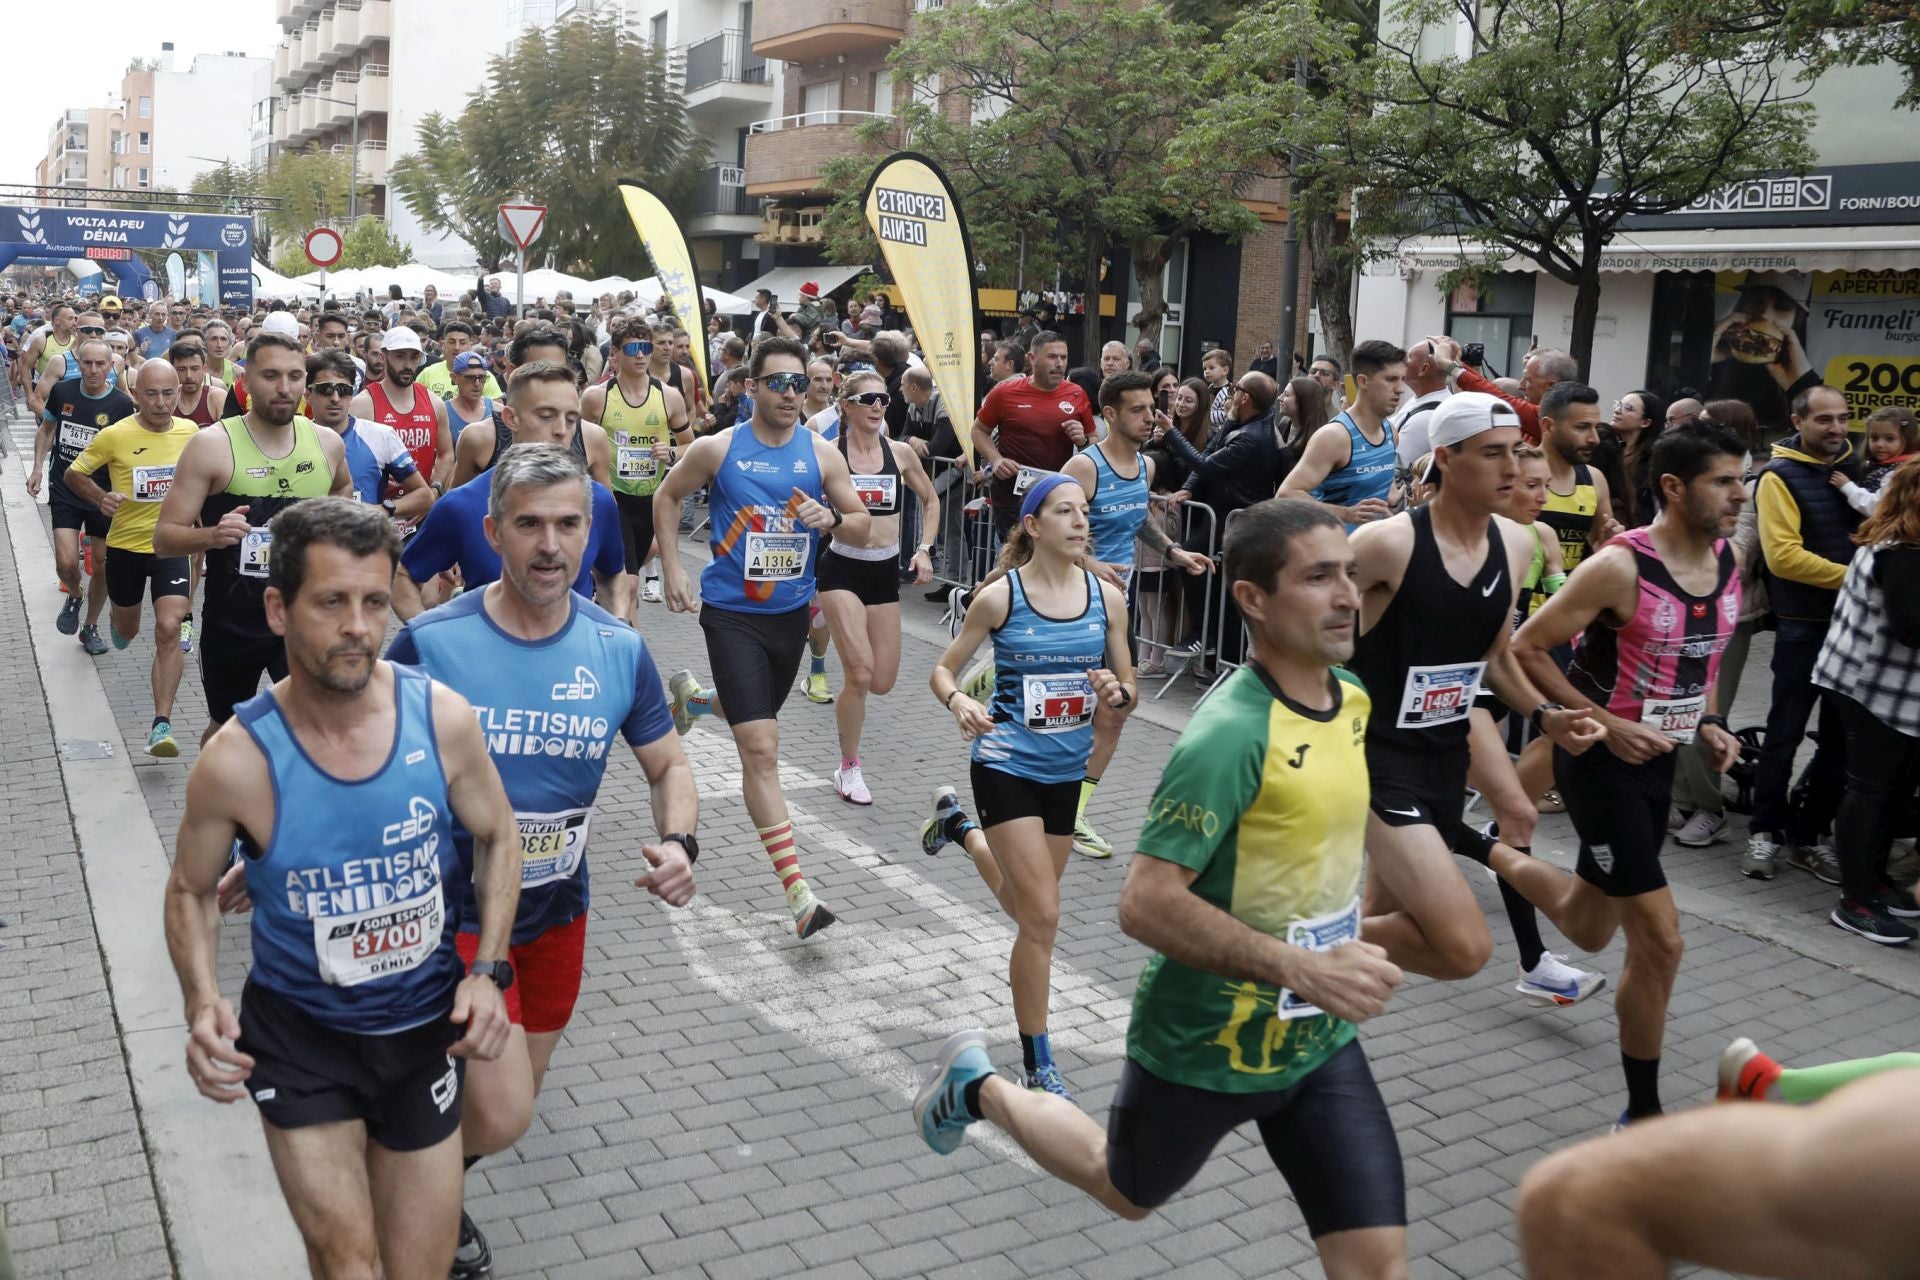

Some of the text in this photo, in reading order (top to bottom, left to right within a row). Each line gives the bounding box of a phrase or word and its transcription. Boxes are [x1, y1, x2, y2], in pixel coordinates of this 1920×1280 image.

[66, 216, 144, 229] VOLTA A PEU
[83, 228, 128, 243] DÉNIA
[87, 248, 131, 259] 00:00:07
[1652, 256, 1718, 268] PASTELERÍA
[1731, 256, 1797, 268] CAFETERÍA
[1829, 279, 1920, 294] APERTUR
[70, 431, 89, 441] 3613
[622, 462, 650, 471] P 1364
[140, 484, 146, 492] E
[865, 492, 872, 502] 3
[249, 552, 257, 562] S
[752, 556, 793, 567] A 1316
[762, 568, 792, 576] BALEARIA
[552, 666, 601, 700] cab
[1411, 691, 1460, 710] P 1487
[1034, 701, 1070, 717] S 2
[1045, 716, 1080, 726] BALEARIA
[383, 796, 438, 846] cab
[519, 819, 567, 833] BALEARIA
[566, 831, 577, 847] C
[363, 917, 393, 931] SOM
[396, 896, 437, 923] ESPORT
[354, 919, 420, 956] 3700
[371, 956, 414, 974] DÉNIA
